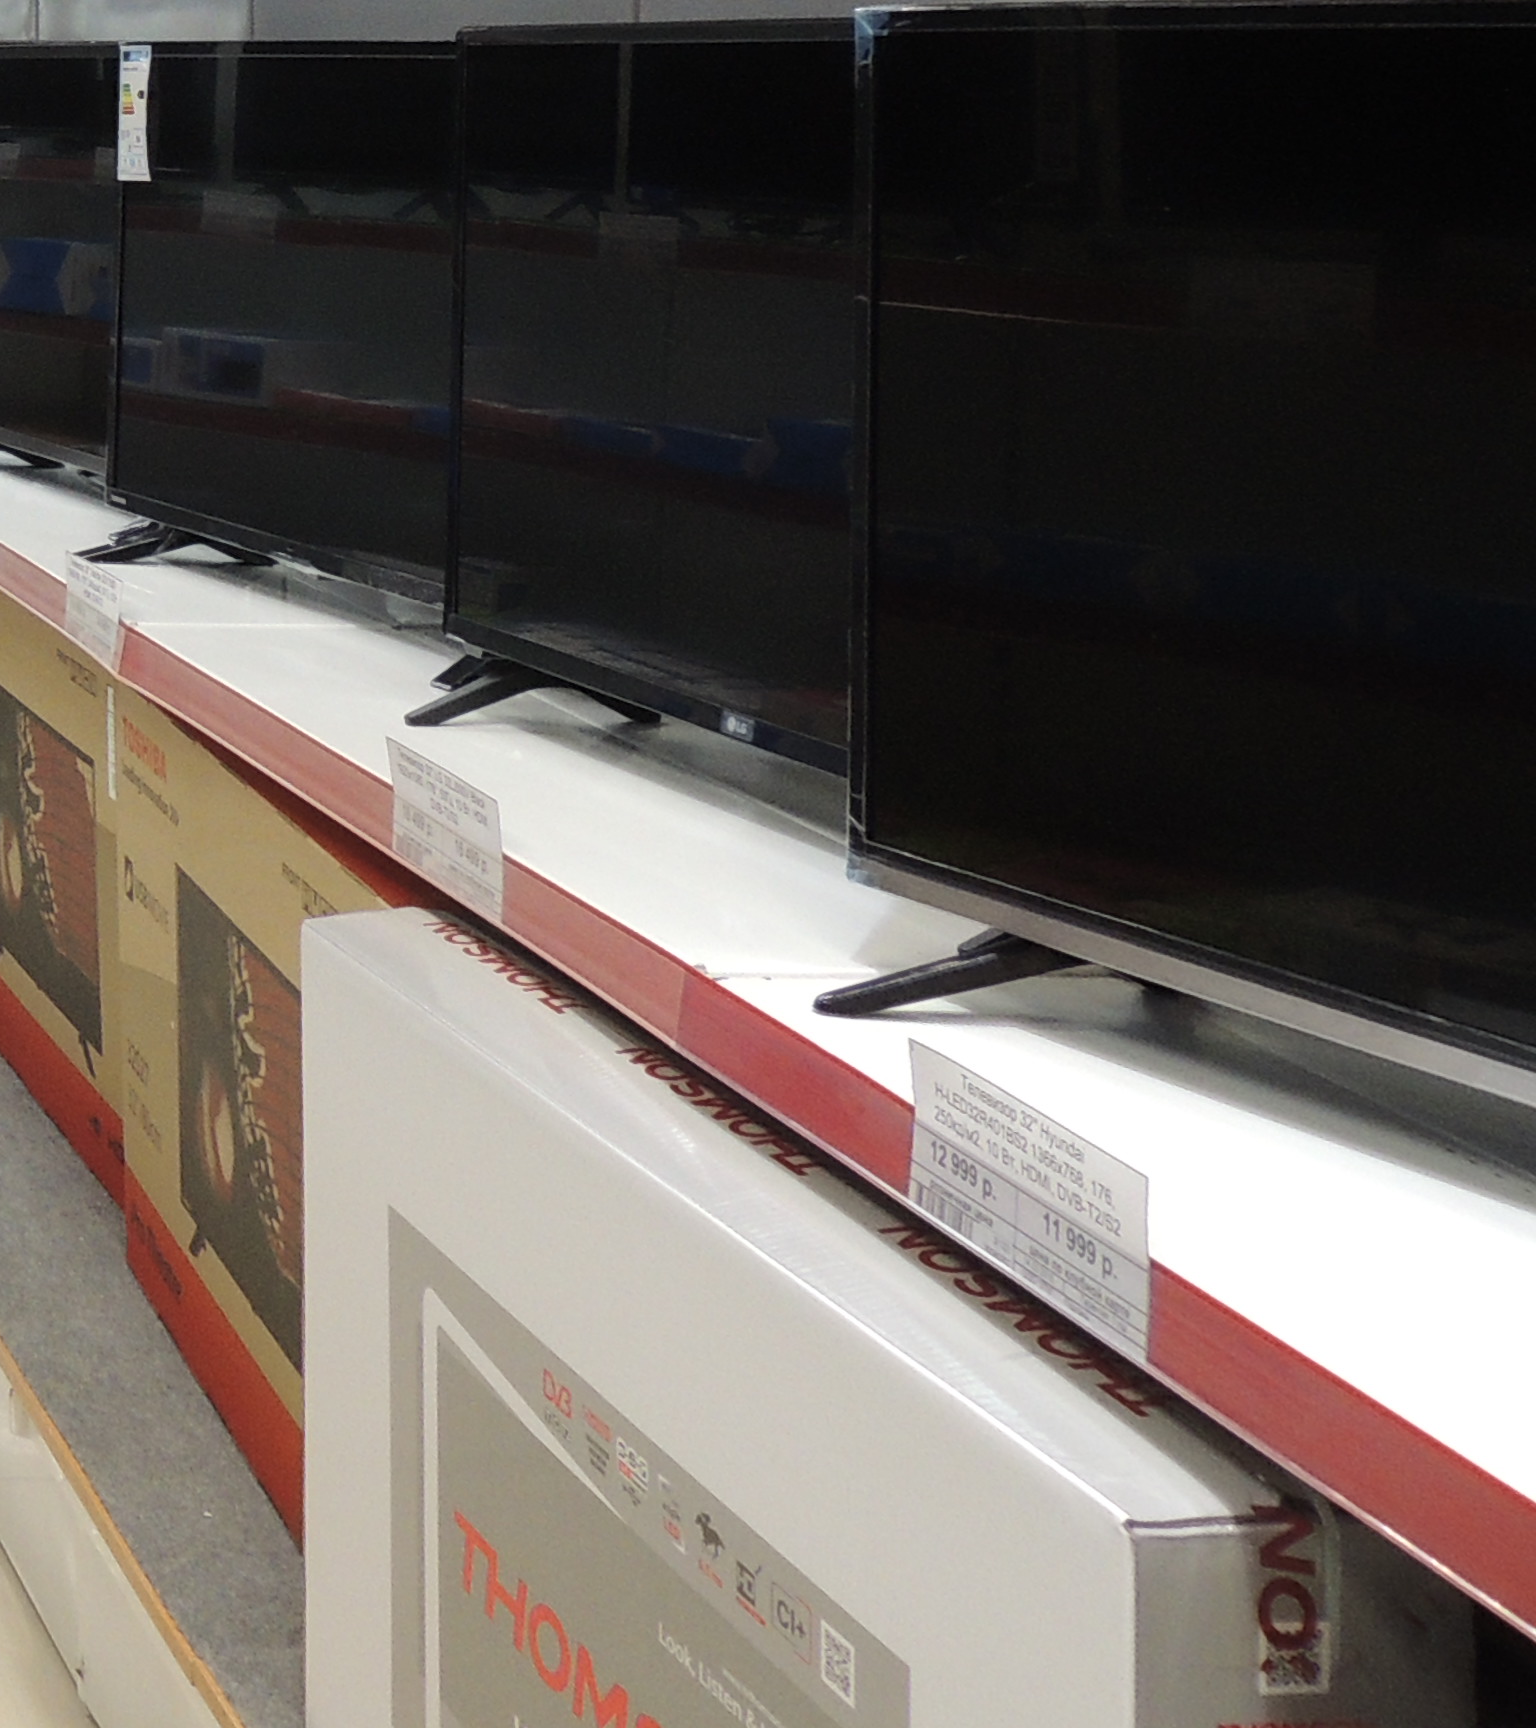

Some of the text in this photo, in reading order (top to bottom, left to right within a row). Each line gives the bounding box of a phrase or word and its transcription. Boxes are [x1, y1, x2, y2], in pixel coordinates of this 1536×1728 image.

[123, 714, 168, 783] TOSHIBA
[422, 920, 586, 1015] THOMSON
[614, 1046, 829, 1178] THOMSON
[960, 1073, 1017, 1122] Телевизор
[1040, 1117, 1086, 1161] Hyundai
[930, 1140, 947, 1169] 12
[950, 1151, 978, 1188] 999
[1042, 1212, 1061, 1243] 11
[1066, 1224, 1097, 1267] 999
[877, 1222, 1156, 1419] THOMSON
[541, 1368, 574, 1419] DVB
[454, 1509, 663, 1728] THOM
[775, 1598, 807, 1642] CI+
[698, 1660, 743, 1721] Listen
